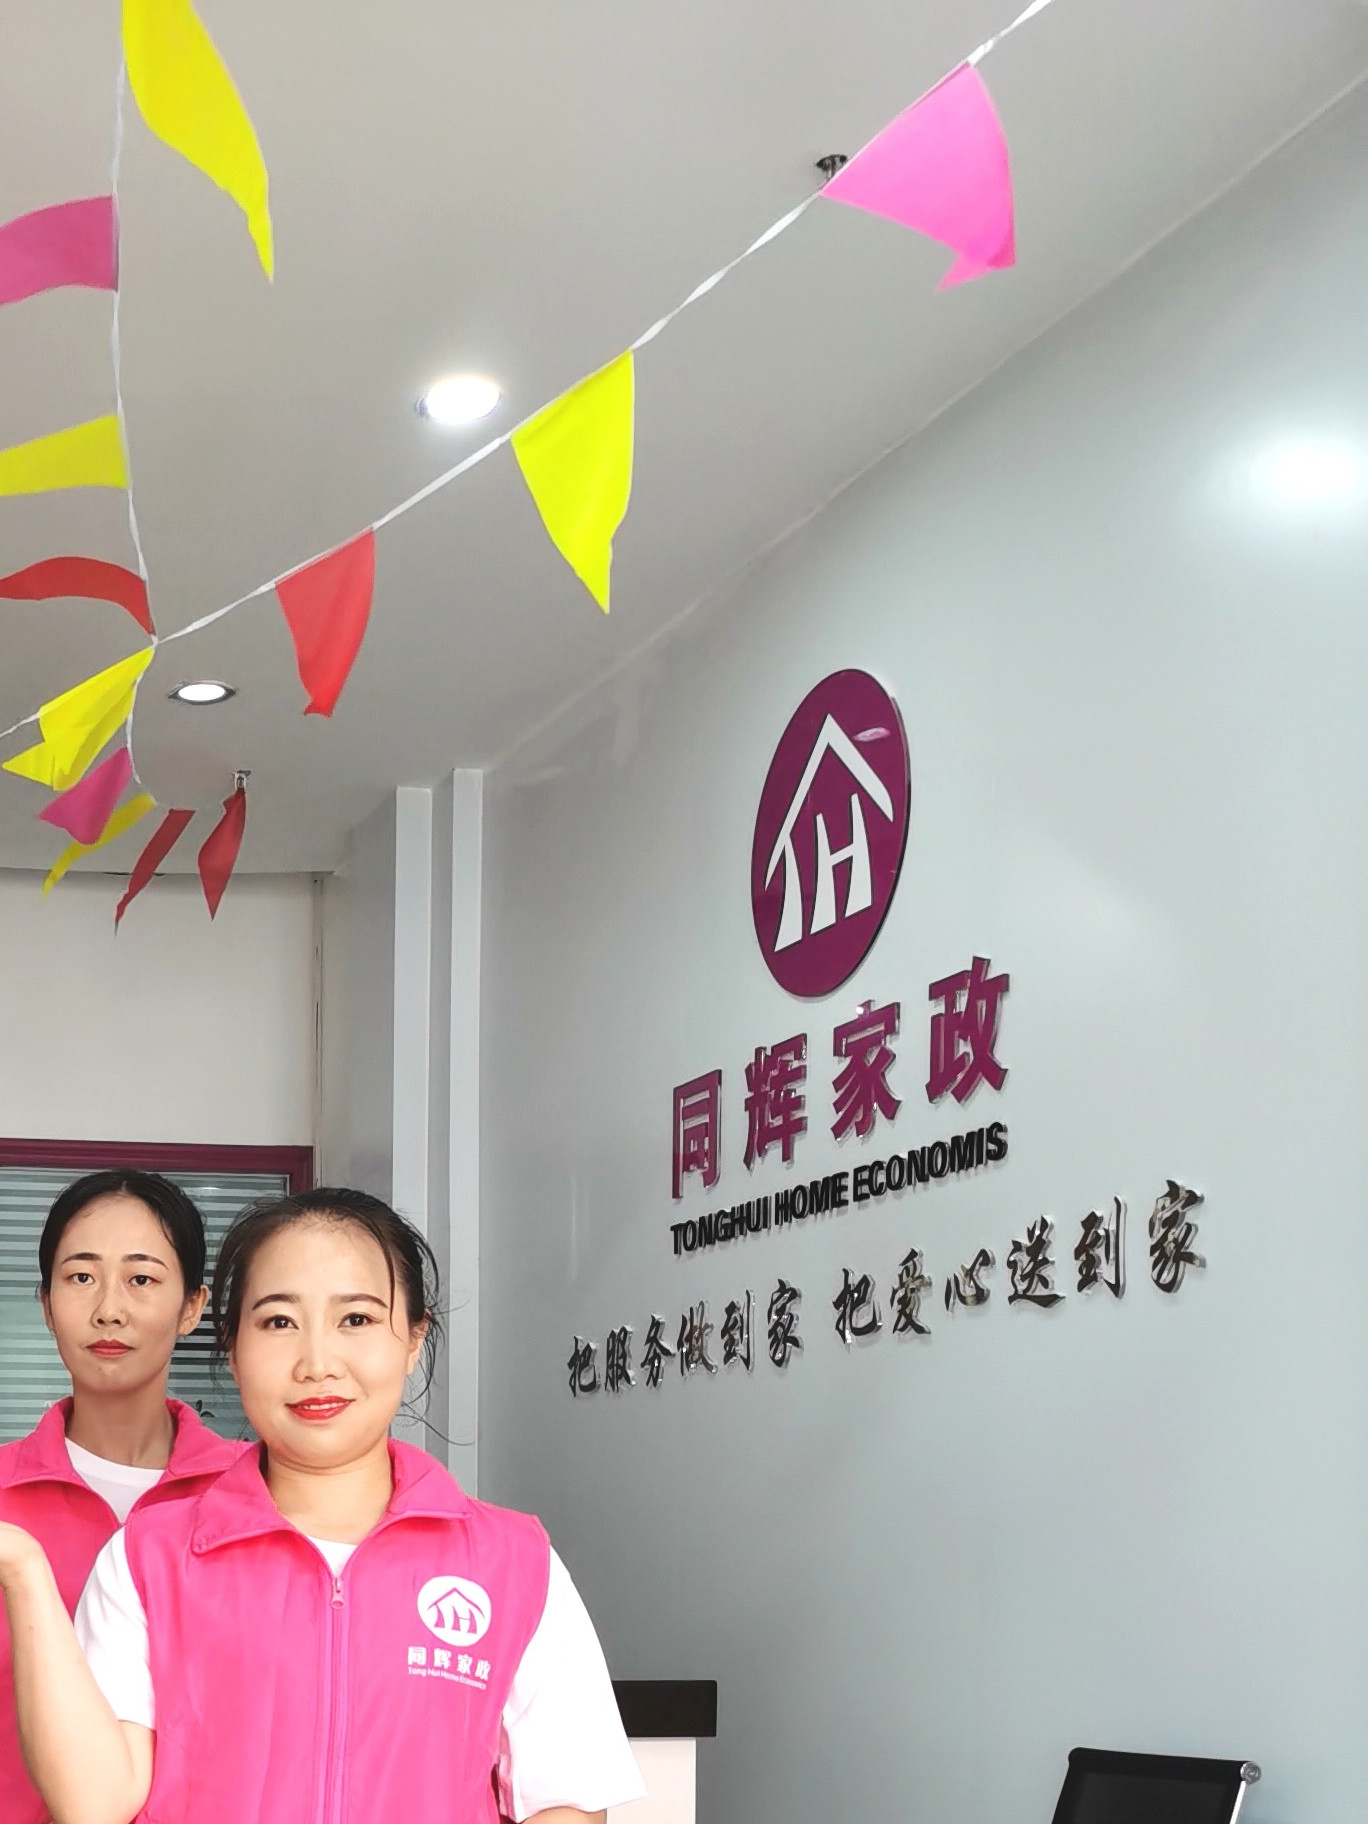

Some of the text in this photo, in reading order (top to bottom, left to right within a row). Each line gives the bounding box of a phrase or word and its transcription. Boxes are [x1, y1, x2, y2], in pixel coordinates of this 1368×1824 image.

[672, 955, 1010, 1200] 同辉家政
[670, 1121, 1009, 1256] TONGHUI HOME ECONOMIS
[568, 1179, 1207, 1397] 把服务做到家 把爱心送到家
[408, 1646, 491, 1681] 同辉家政
